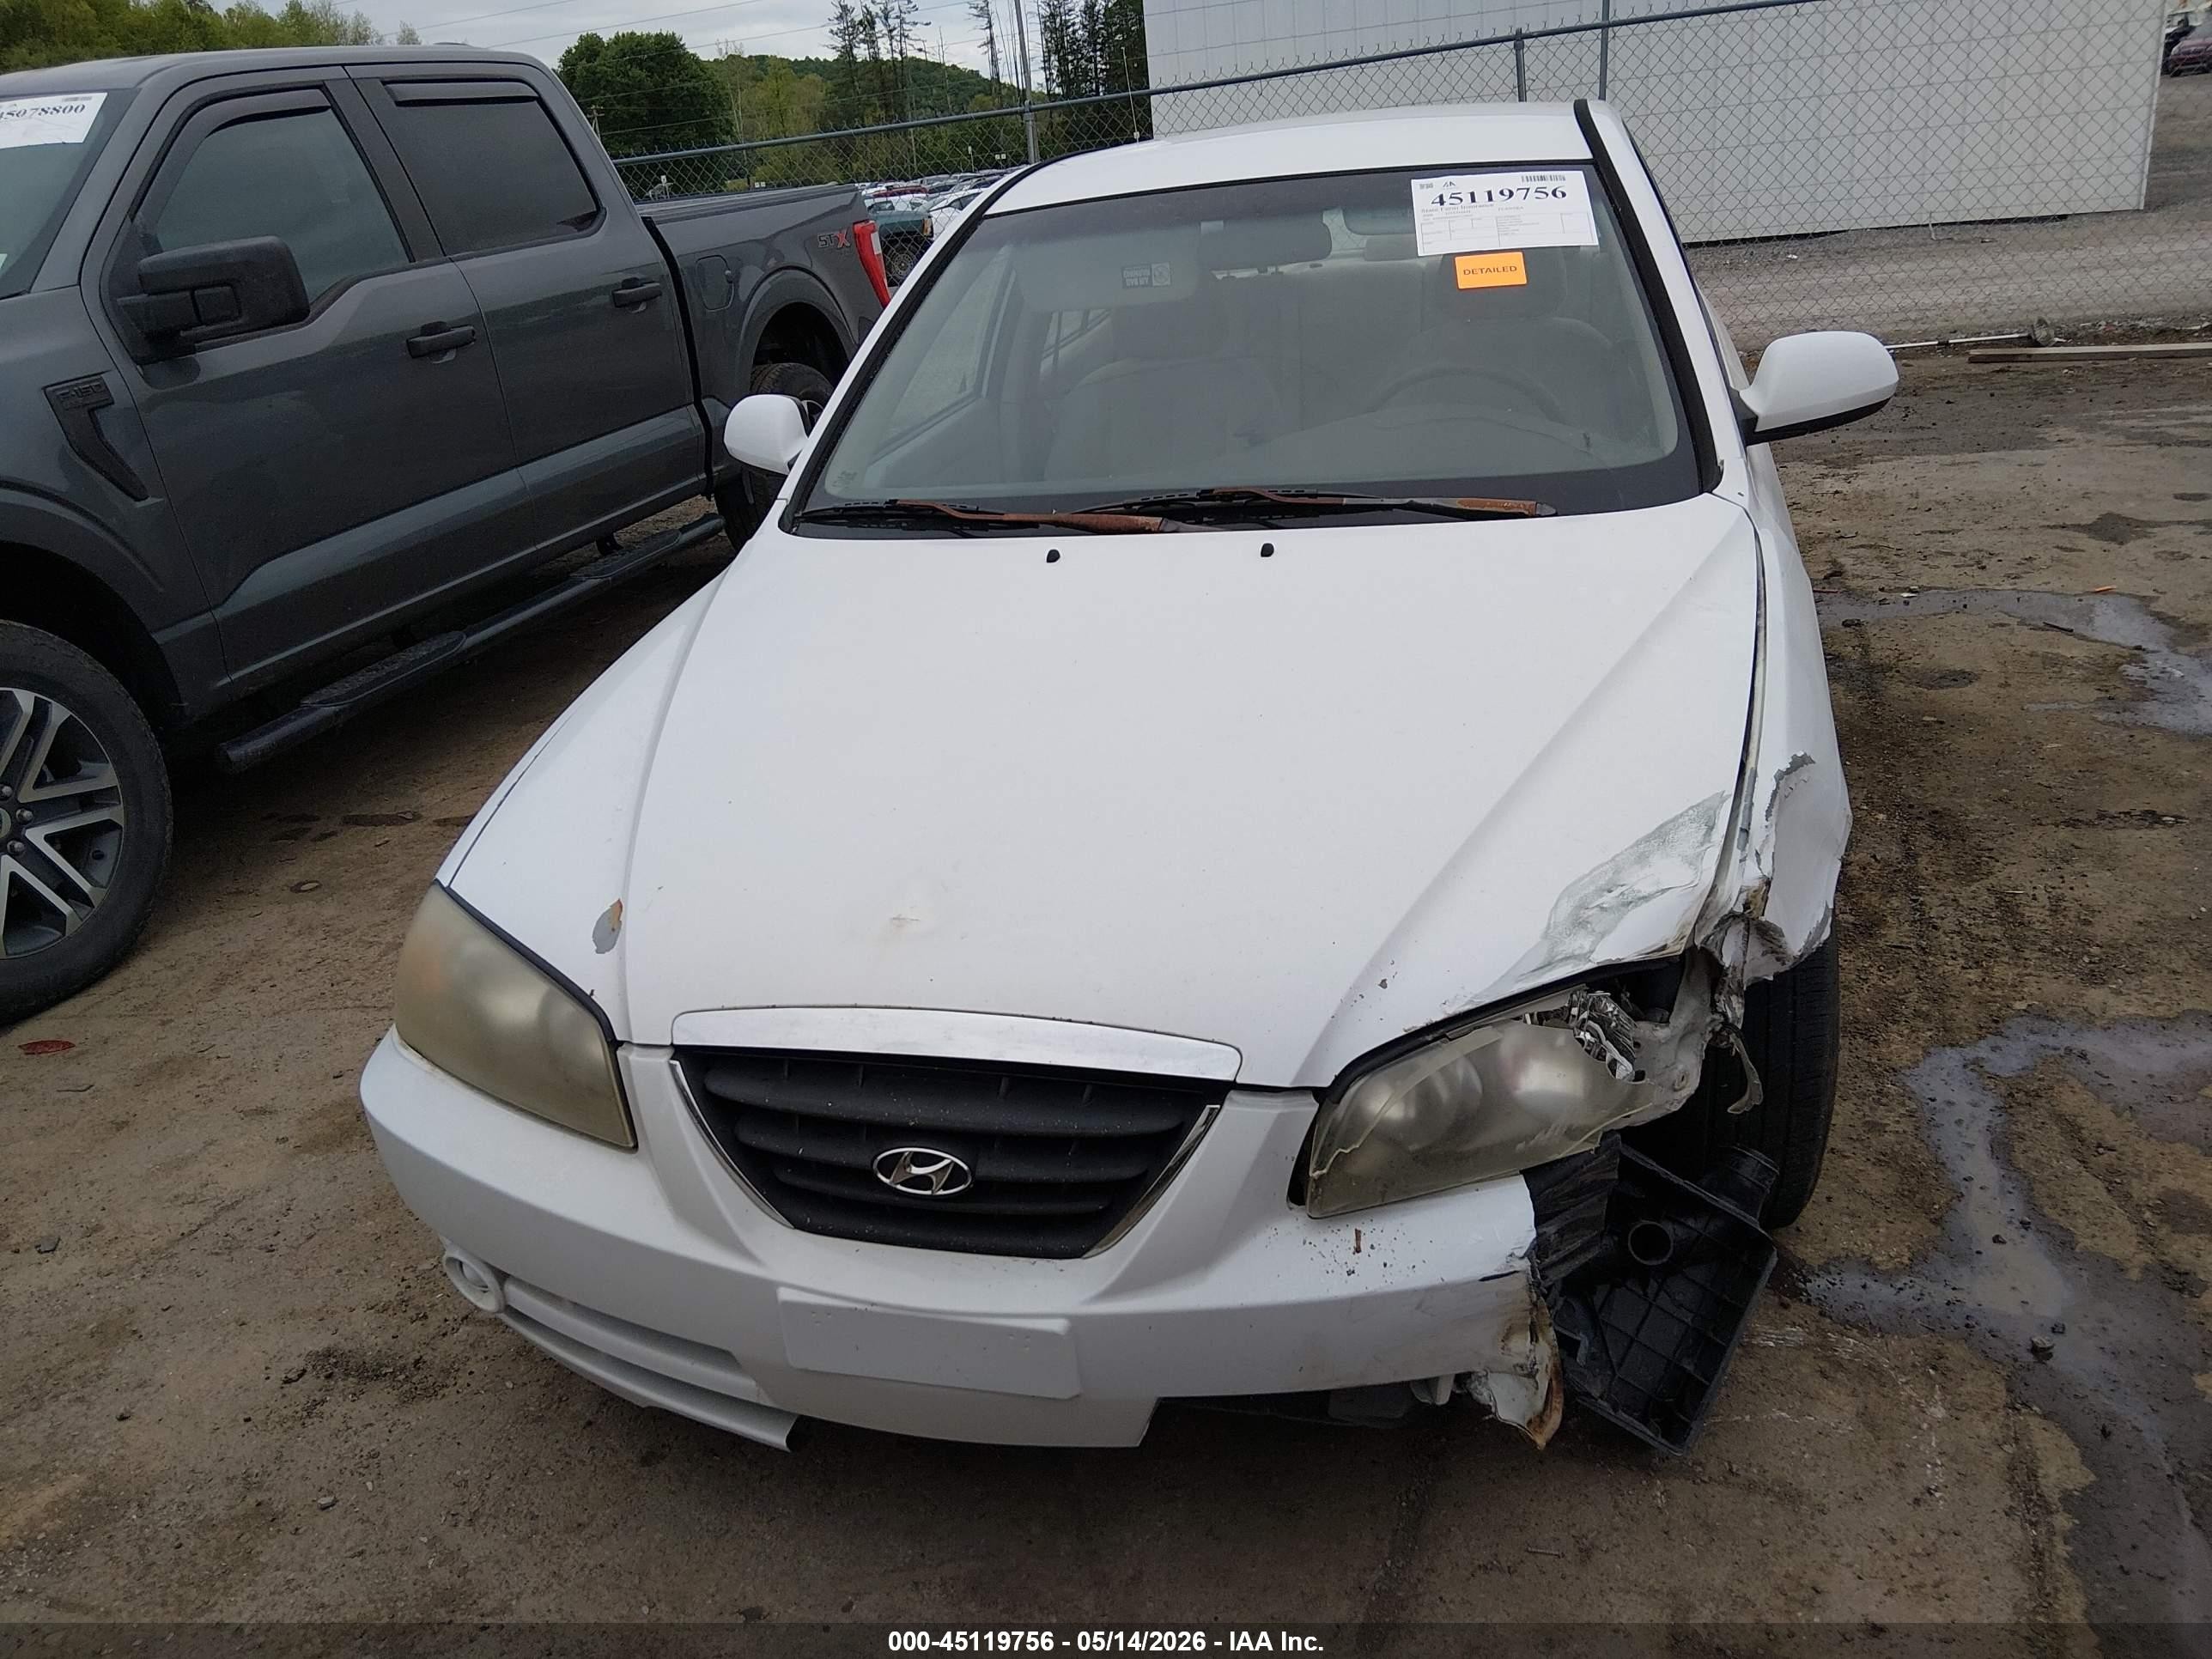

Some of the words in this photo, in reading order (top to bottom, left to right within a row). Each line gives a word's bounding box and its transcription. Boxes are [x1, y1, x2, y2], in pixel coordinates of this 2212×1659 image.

[1431, 186, 1567, 206] 45119756
[817, 231, 851, 248] STX
[1463, 265, 1517, 276] DETAILED
